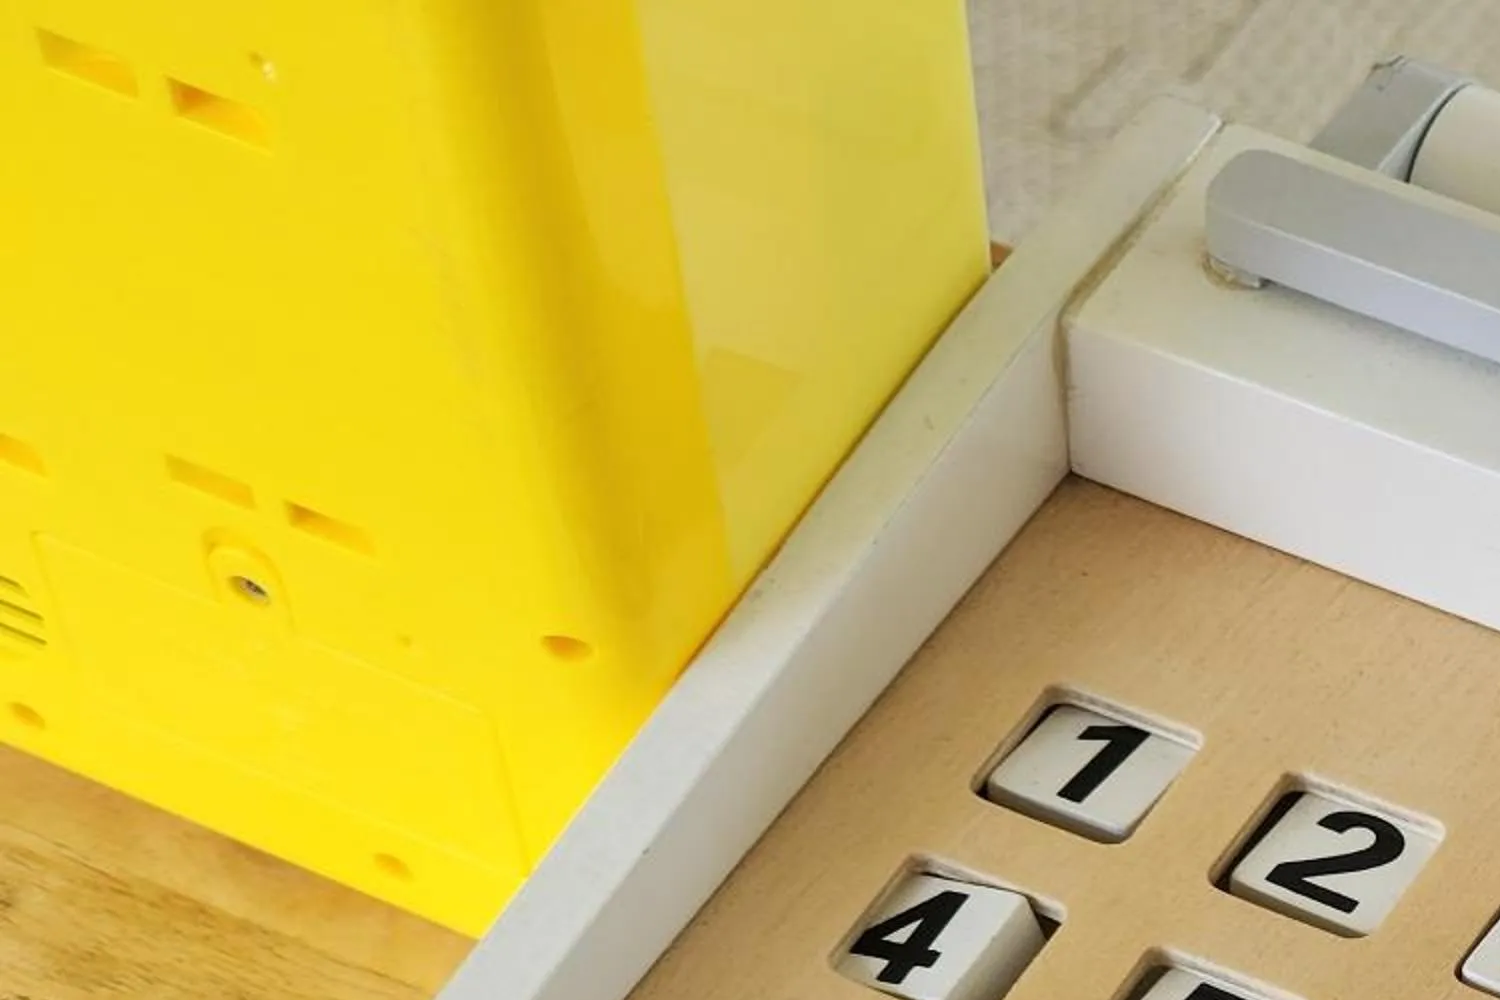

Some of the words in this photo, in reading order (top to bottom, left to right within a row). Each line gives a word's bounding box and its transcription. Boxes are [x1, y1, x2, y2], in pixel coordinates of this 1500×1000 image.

[1057, 724, 1152, 804] 1
[1266, 811, 1405, 914] 2
[848, 890, 969, 985] 4
